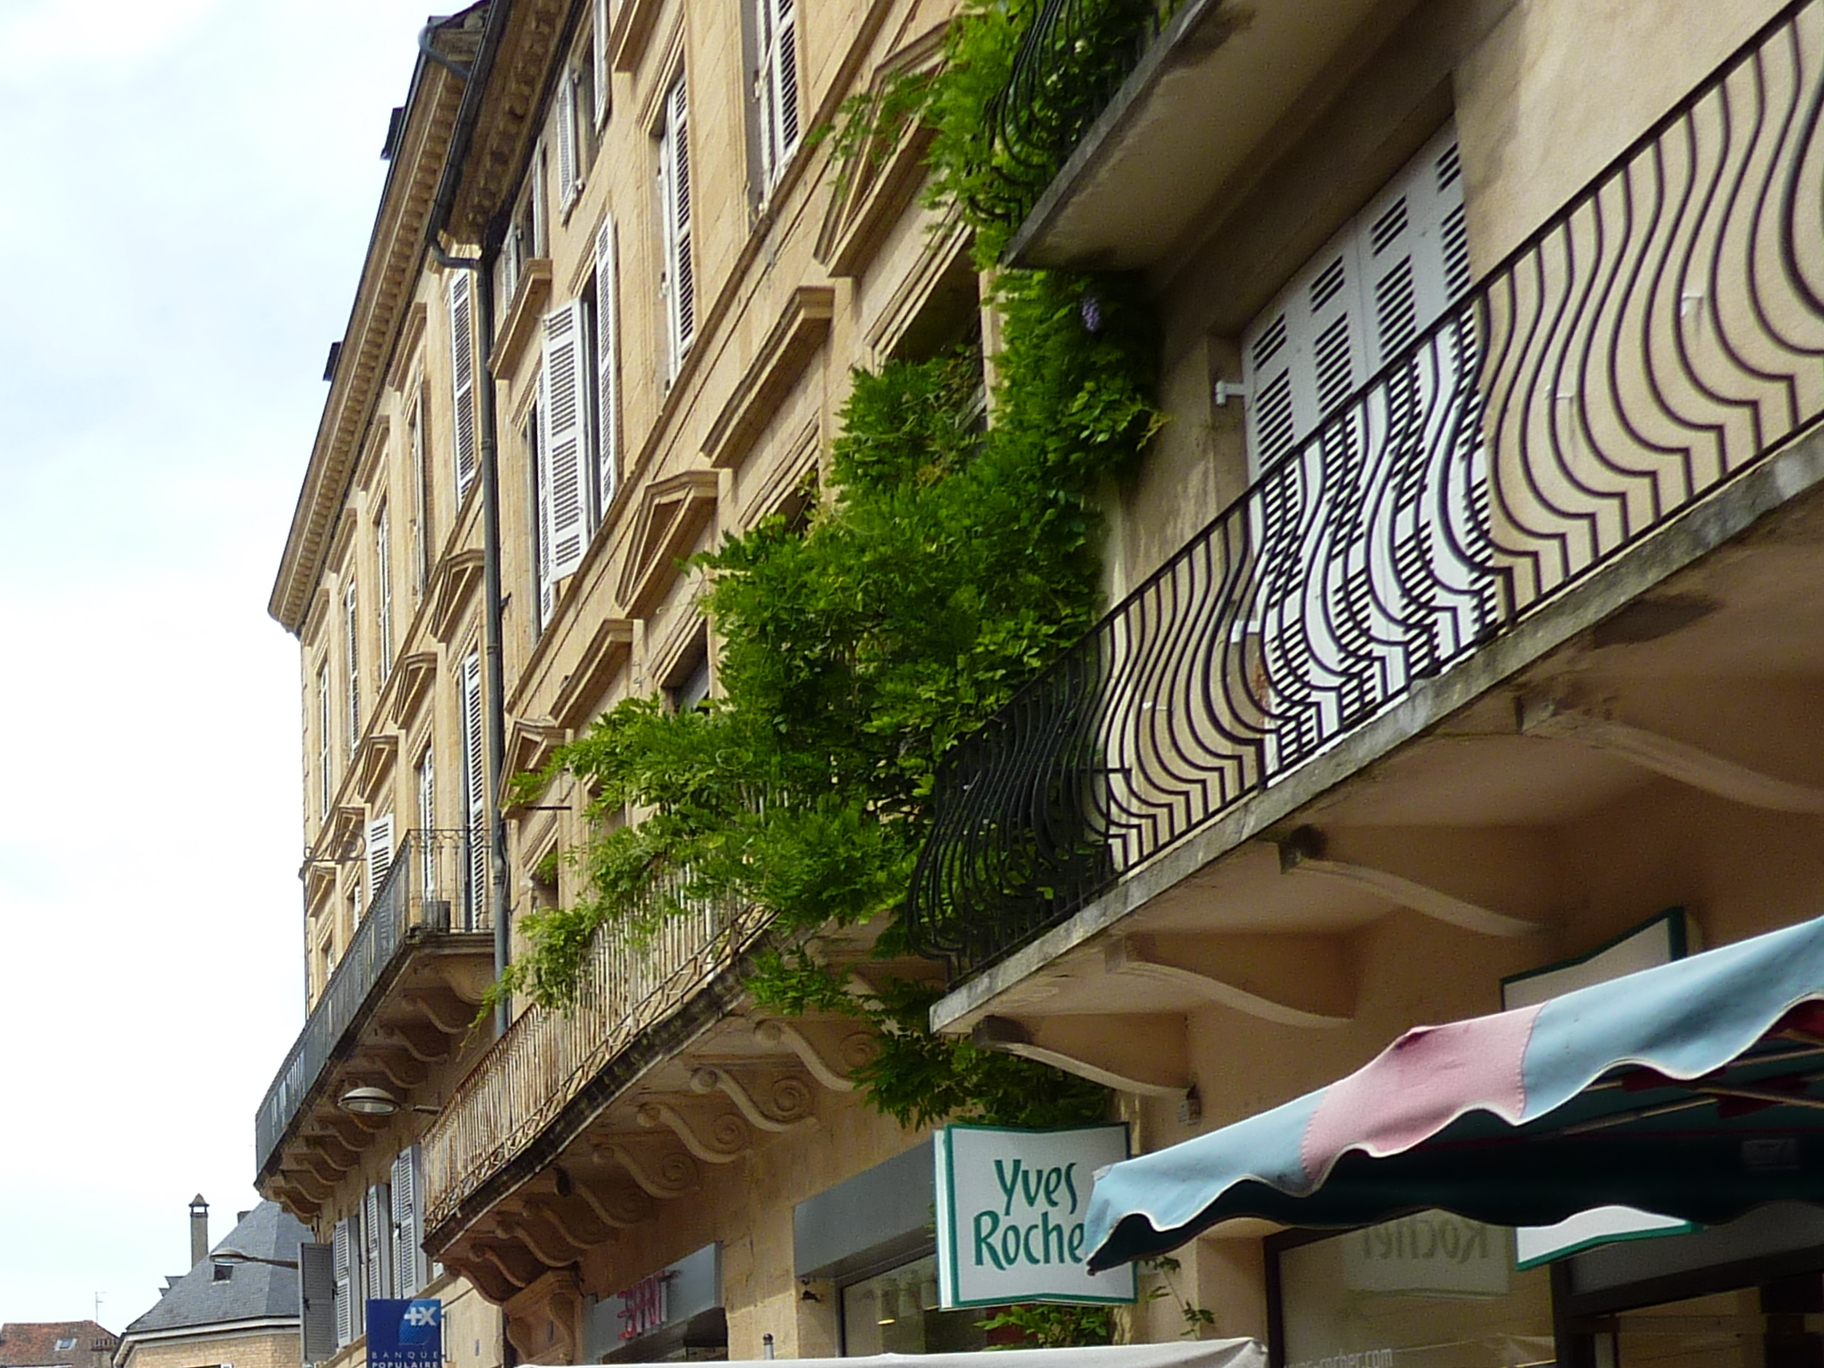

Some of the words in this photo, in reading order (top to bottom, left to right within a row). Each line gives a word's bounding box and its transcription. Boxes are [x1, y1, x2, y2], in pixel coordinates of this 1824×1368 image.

[994, 1159, 1077, 1216] Yves
[973, 1210, 1086, 1271] Roche
[371, 1351, 439, 1360] BANQUE
